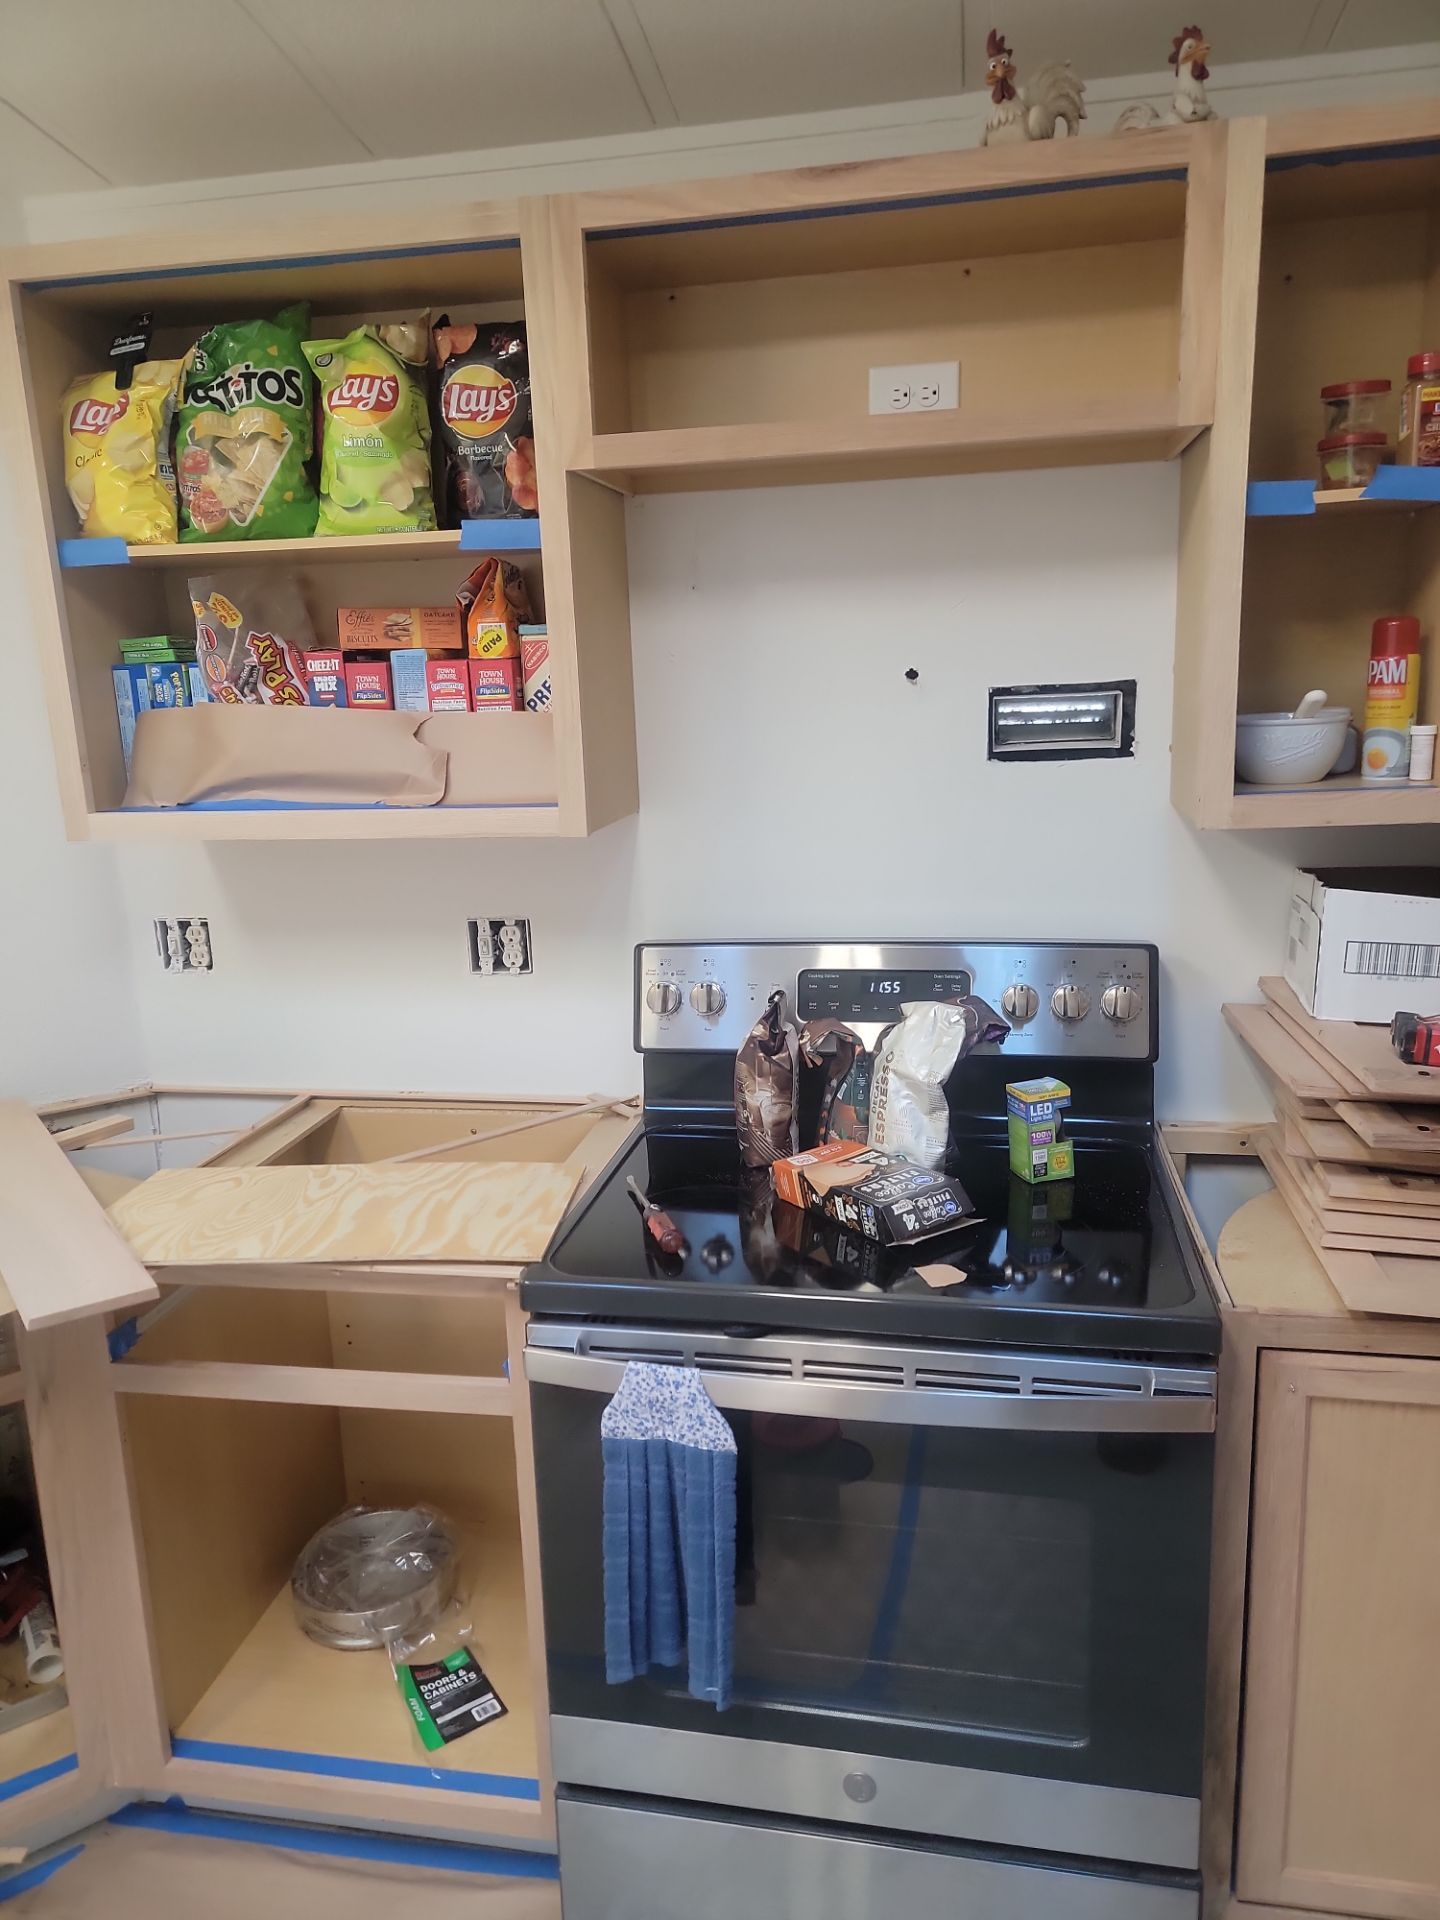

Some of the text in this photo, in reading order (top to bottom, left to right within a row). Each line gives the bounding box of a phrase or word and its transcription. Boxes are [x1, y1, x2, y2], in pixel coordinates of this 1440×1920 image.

[330, 373, 397, 411] Lay's
[449, 384, 512, 424] Lay's
[343, 433, 383, 448] Limón
[458, 444, 503, 455] Barbecue
[482, 633, 503, 653] PAID
[252, 639, 288, 688] PLAY
[306, 658, 340, 672] CHEEZ-IT
[526, 644, 546, 668] NABISCO
[479, 670, 503, 678] TOWN
[480, 677, 504, 685] HOUSE
[1367, 658, 1407, 685] PAM
[315, 681, 338, 691] MIX
[356, 682, 381, 690] HOUSE
[526, 676, 552, 712] PRE
[874, 1051, 895, 1145] ESPRESSO
[1030, 1102, 1052, 1117] LED
[860, 1169, 920, 1193] FILTERS
[875, 1181, 916, 1199] Coffee
[917, 1191, 951, 1210] FILTERS
[923, 1204, 946, 1219] Coffee
[419, 1672, 457, 1693] DOORS
[458, 1668, 468, 1677] &
[424, 1671, 477, 1700] CABINETS
[408, 1697, 426, 1722] FOAM
